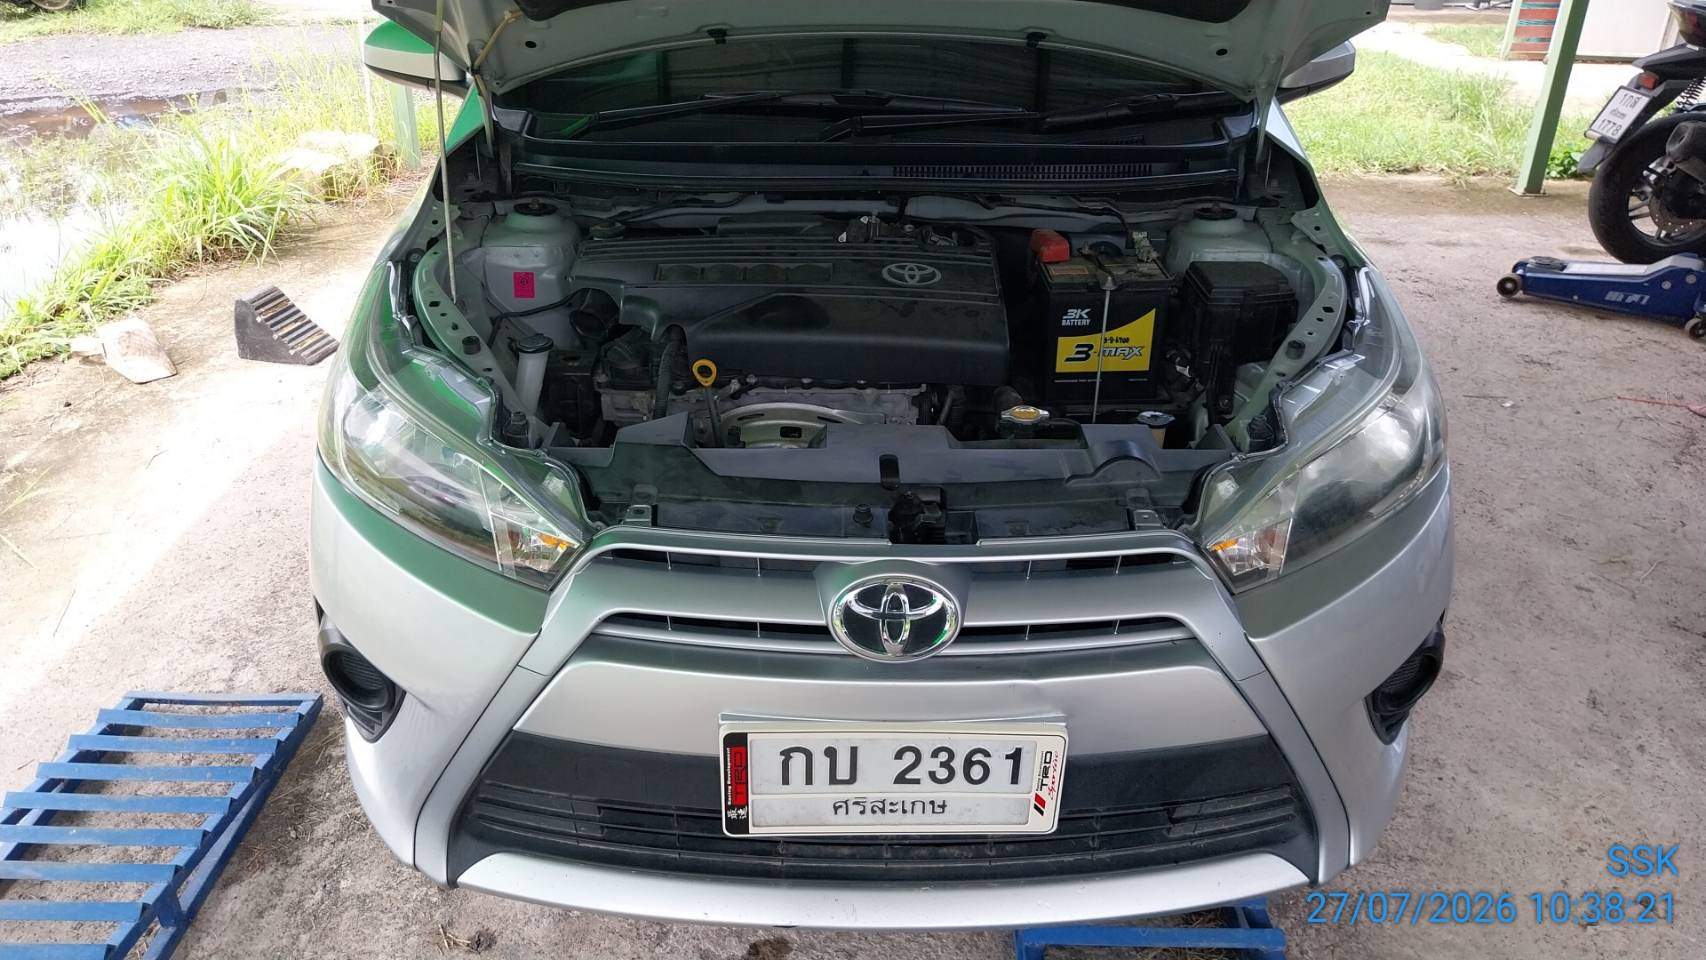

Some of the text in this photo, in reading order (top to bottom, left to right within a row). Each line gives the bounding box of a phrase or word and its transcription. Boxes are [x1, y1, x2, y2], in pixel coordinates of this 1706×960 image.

[1062, 308, 1092, 319] 3K
[734, 752, 747, 802] TRD
[779, 745, 1023, 786] กบ 2361
[1040, 751, 1052, 791] TRD
